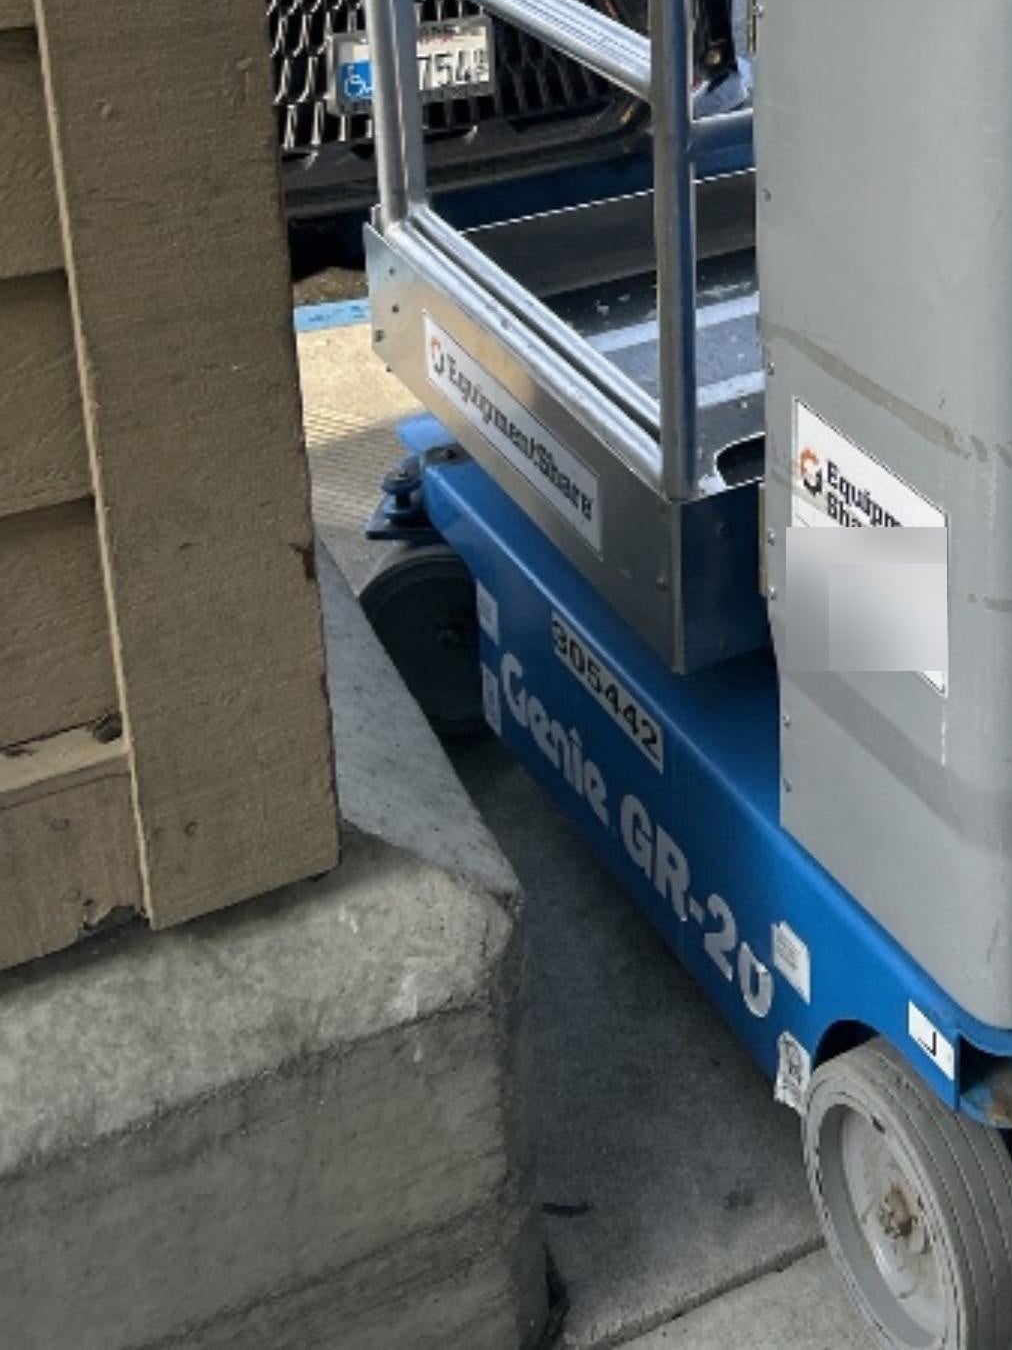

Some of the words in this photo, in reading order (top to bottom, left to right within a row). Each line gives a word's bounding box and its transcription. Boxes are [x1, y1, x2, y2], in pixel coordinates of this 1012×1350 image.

[552, 617, 662, 763] 305442
[500, 651, 610, 827] Genie
[620, 793, 774, 1018] GR-20
